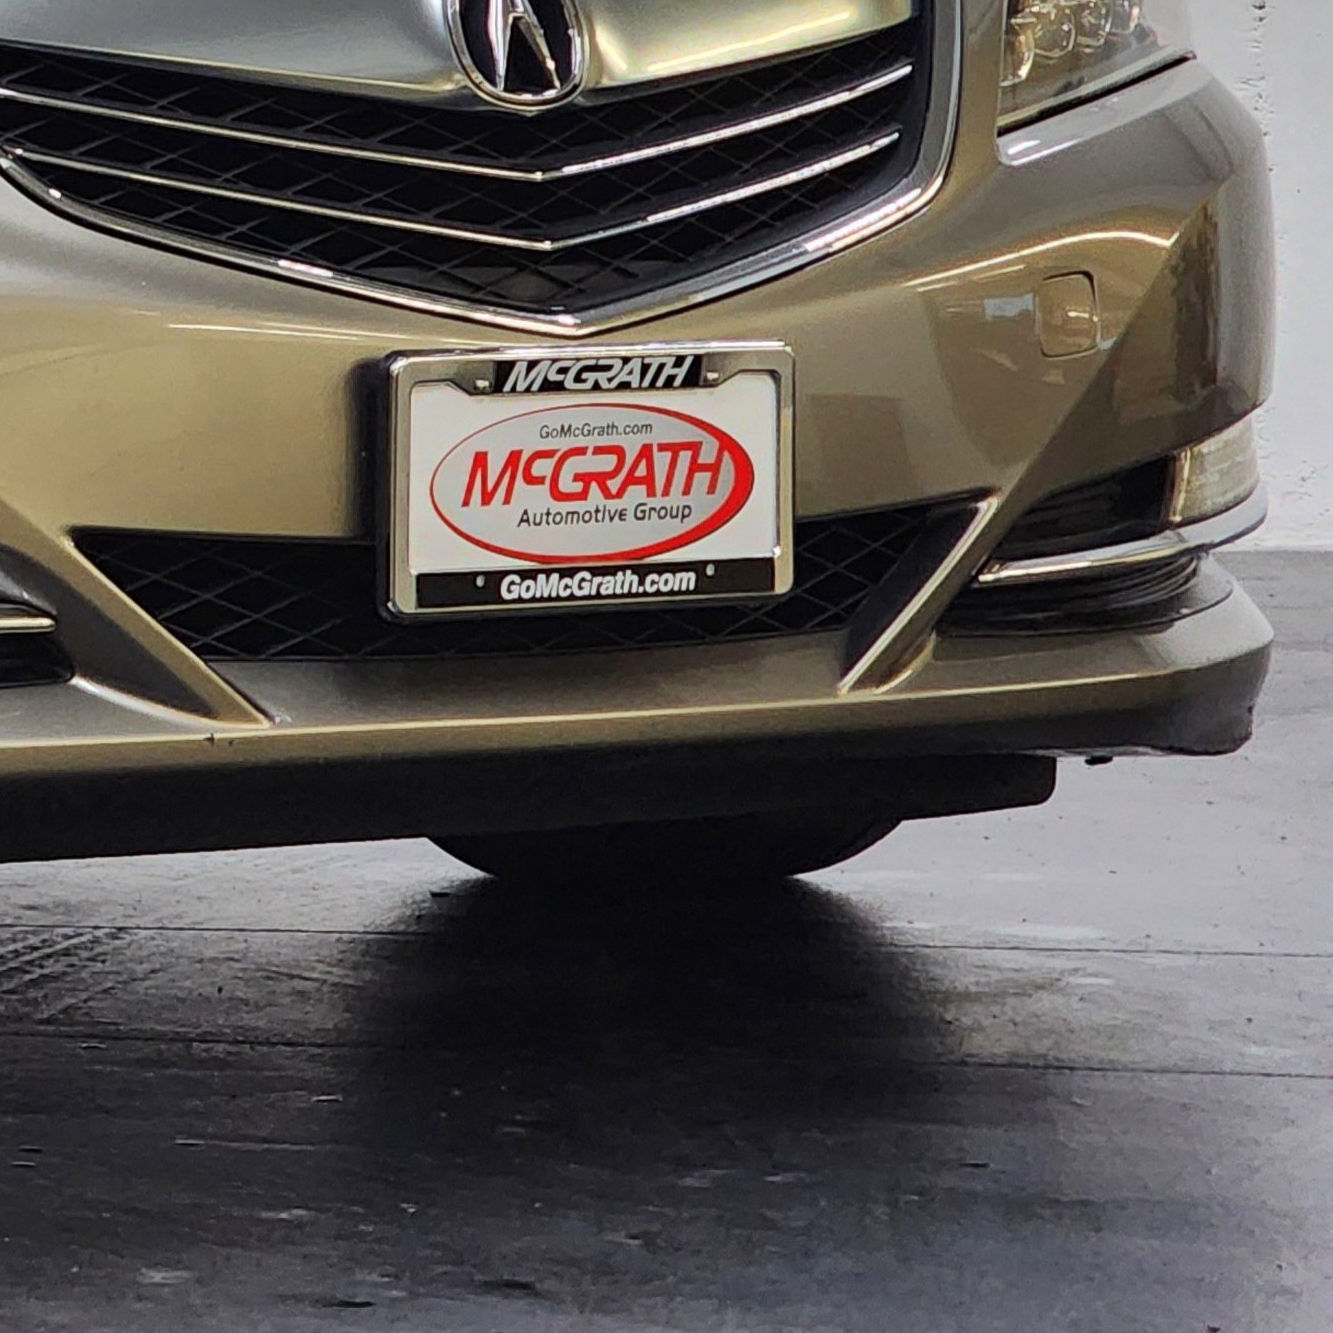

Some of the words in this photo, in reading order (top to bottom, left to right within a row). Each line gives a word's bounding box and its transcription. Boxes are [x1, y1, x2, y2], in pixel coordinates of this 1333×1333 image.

[539, 422, 653, 439] GoMcGrath.com
[517, 504, 628, 528] Automotive
[634, 502, 692, 523] Group
[500, 569, 696, 600] GoMcGrath.com
